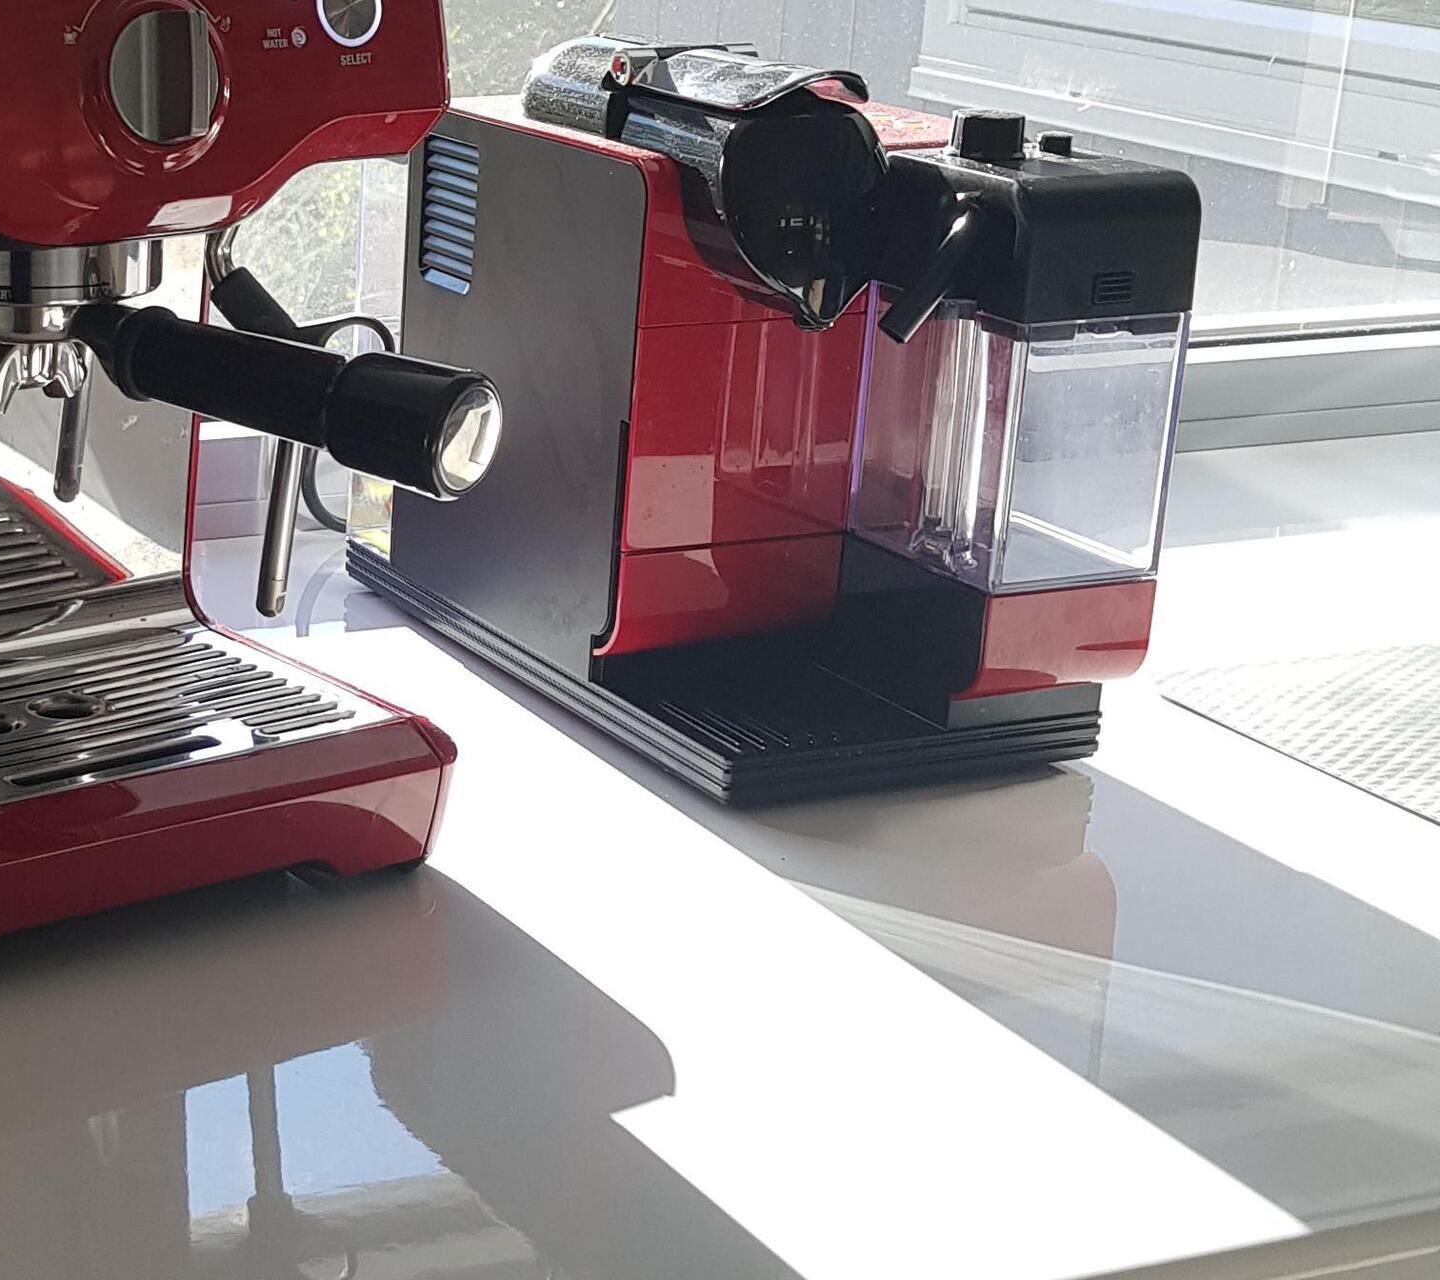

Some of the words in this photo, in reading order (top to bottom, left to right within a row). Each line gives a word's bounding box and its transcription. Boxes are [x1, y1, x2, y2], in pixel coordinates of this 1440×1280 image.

[266, 28, 282, 38] HOT
[263, 39, 289, 49] WATER
[340, 52, 373, 66] SELECT
